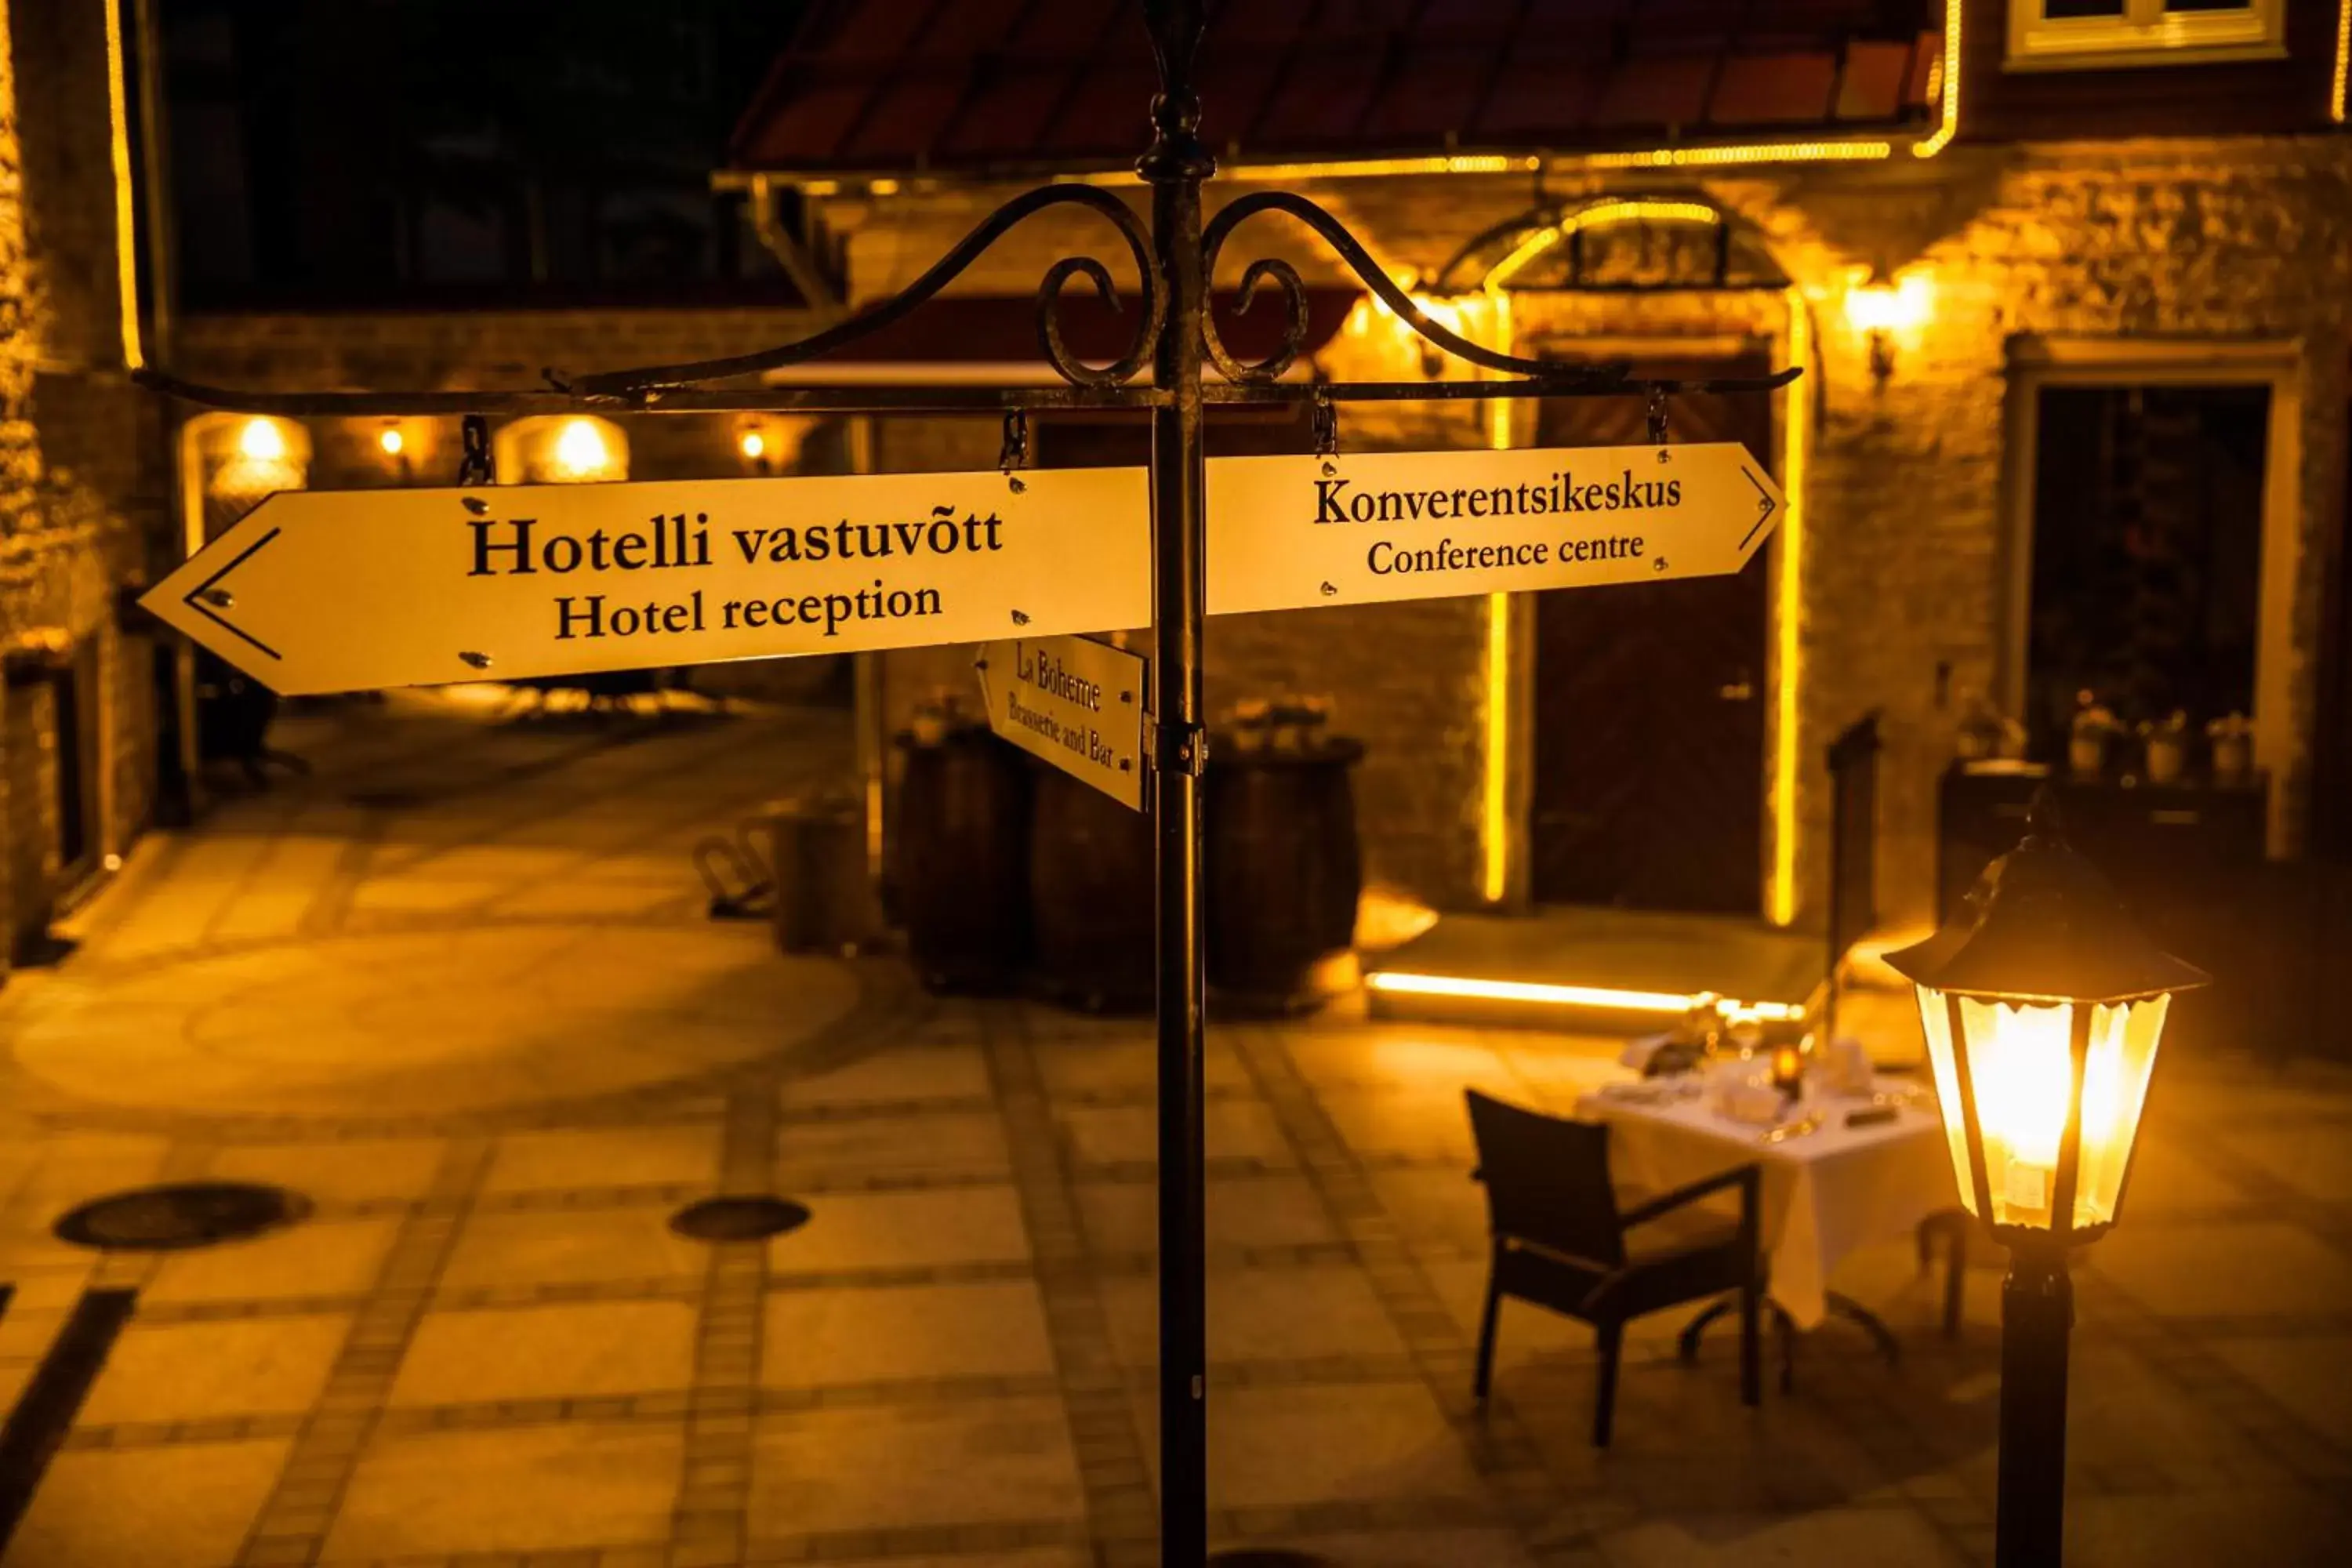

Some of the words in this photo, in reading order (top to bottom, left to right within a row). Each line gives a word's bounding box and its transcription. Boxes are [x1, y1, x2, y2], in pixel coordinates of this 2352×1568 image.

[1313, 470, 1682, 524] Konverentsikeskus
[466, 513, 713, 577] Hotelli
[732, 505, 1003, 564] vastuvõtt
[1367, 538, 1548, 575] Conference
[1558, 534, 1645, 563] centre
[553, 591, 705, 640] Hotel
[722, 579, 943, 636] reception
[1017, 641, 1033, 684] La
[1038, 650, 1101, 712] Boheme
[1009, 691, 1061, 742] Brasserie
[1064, 724, 1085, 756] and
[1090, 729, 1113, 768] Bar
